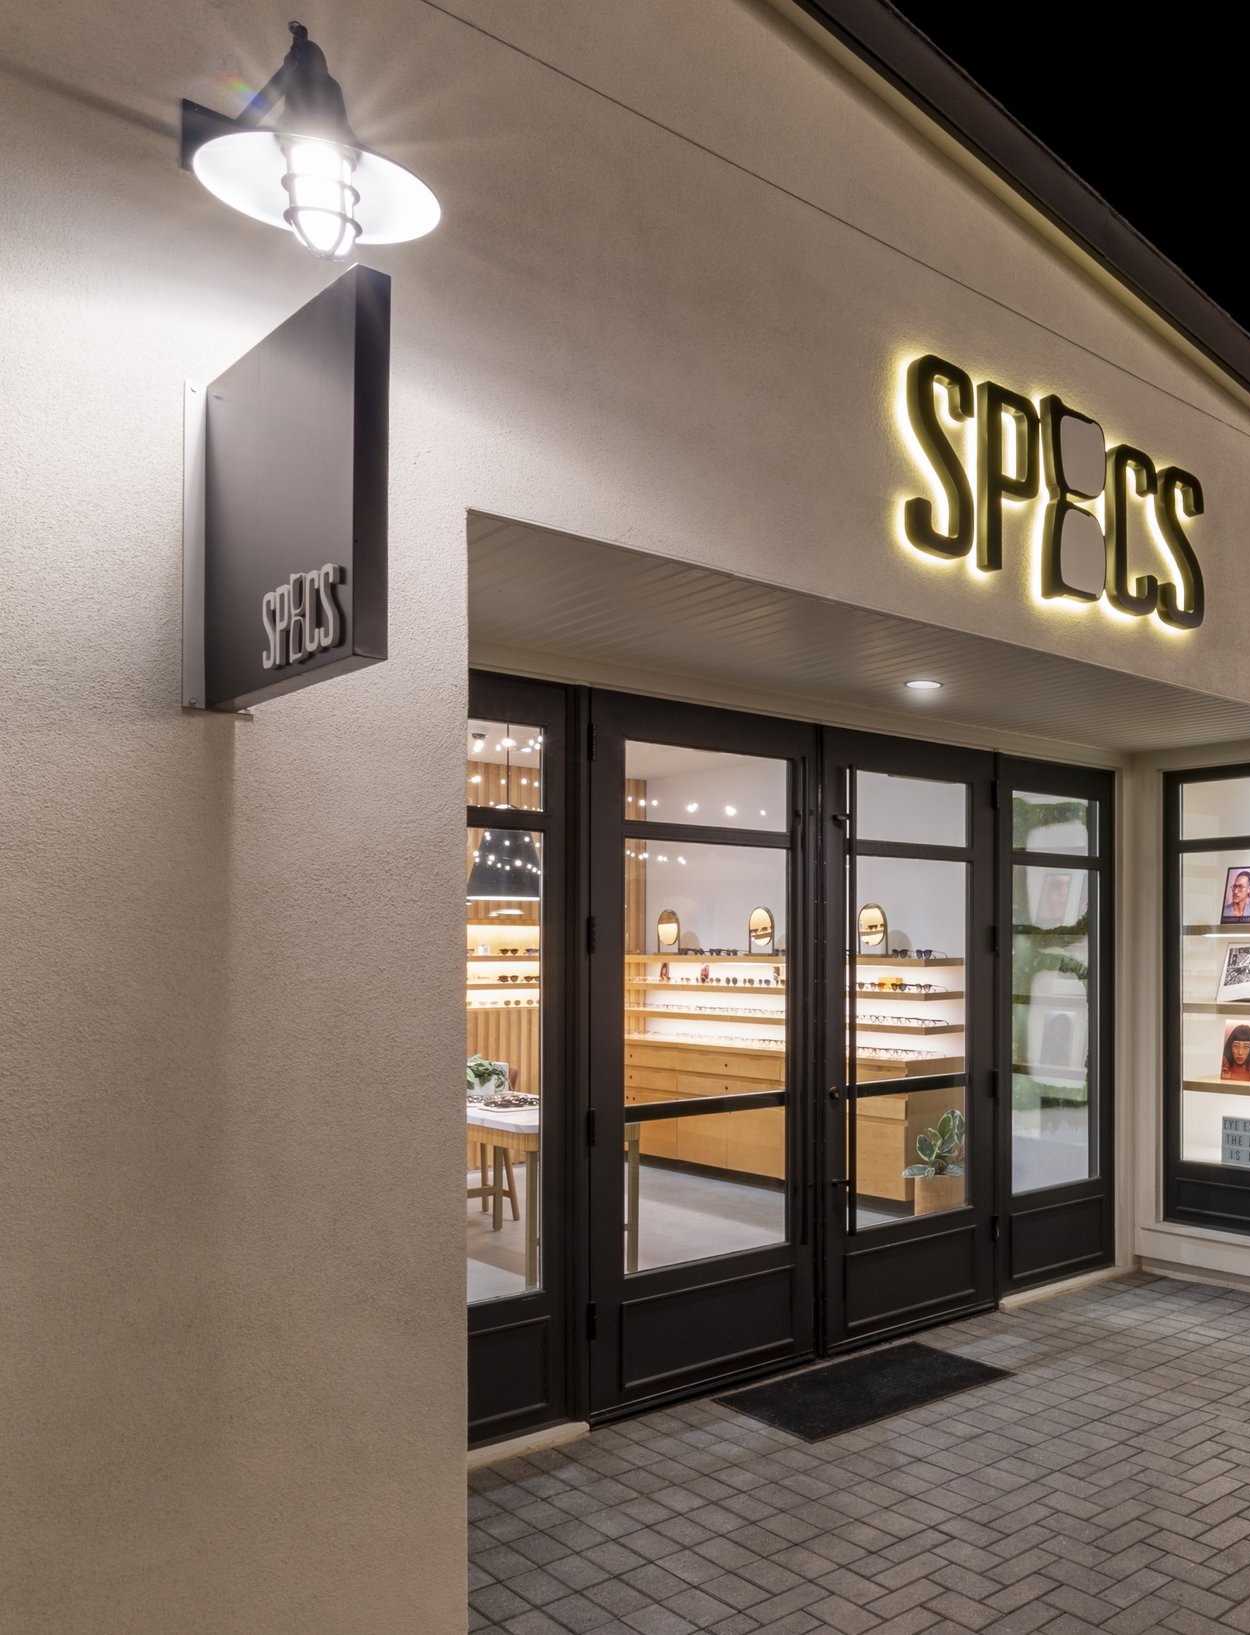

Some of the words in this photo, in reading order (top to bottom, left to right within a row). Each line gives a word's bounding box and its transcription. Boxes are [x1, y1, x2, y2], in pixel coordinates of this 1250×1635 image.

[904, 353, 1205, 631] SPECS
[262, 563, 341, 670] SPECS
[1223, 1119, 1239, 1131] EYE
[1226, 1134, 1242, 1147] THE
[1230, 1150, 1240, 1161] IS
